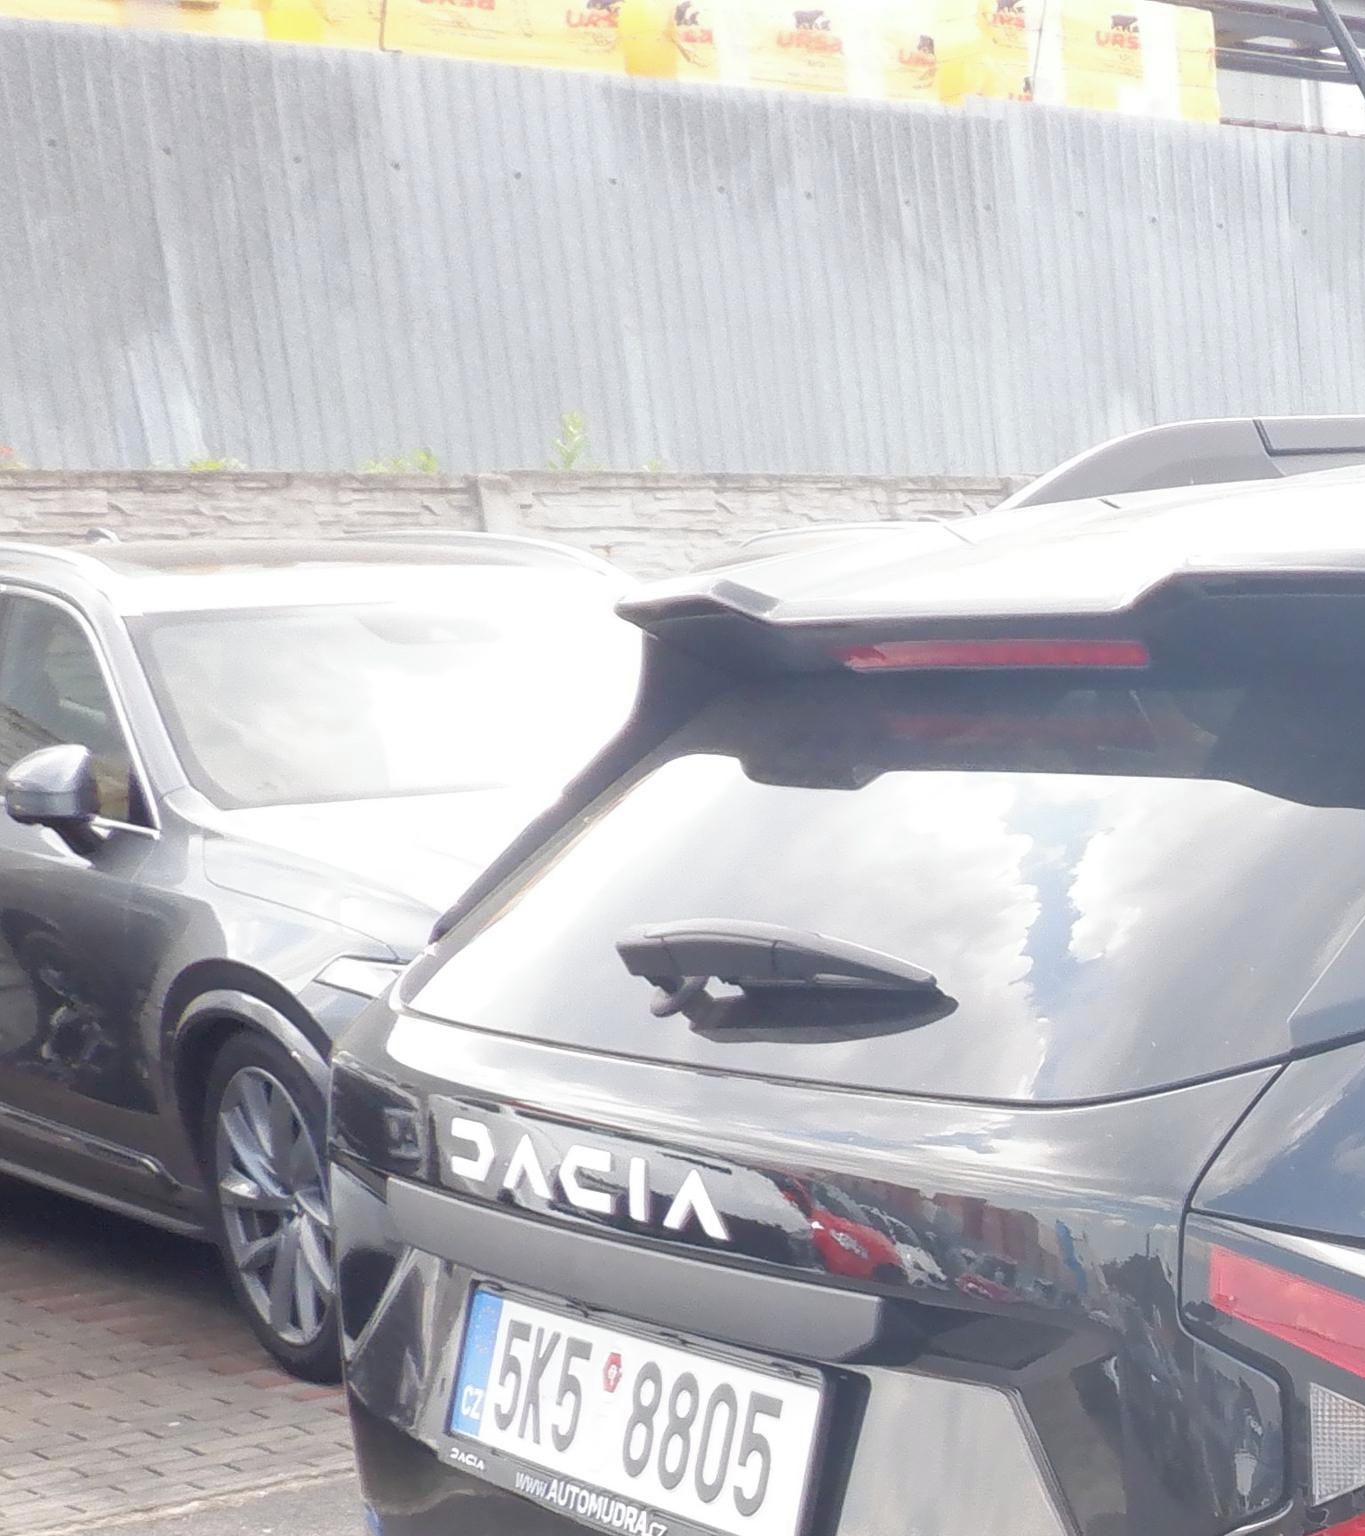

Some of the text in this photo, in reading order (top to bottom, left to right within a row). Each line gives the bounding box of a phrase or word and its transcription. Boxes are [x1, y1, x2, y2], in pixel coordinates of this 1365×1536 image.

[451, 1117, 730, 1241] DACIA
[461, 1384, 483, 1419] CZ
[494, 1319, 784, 1517] 5K5 8805
